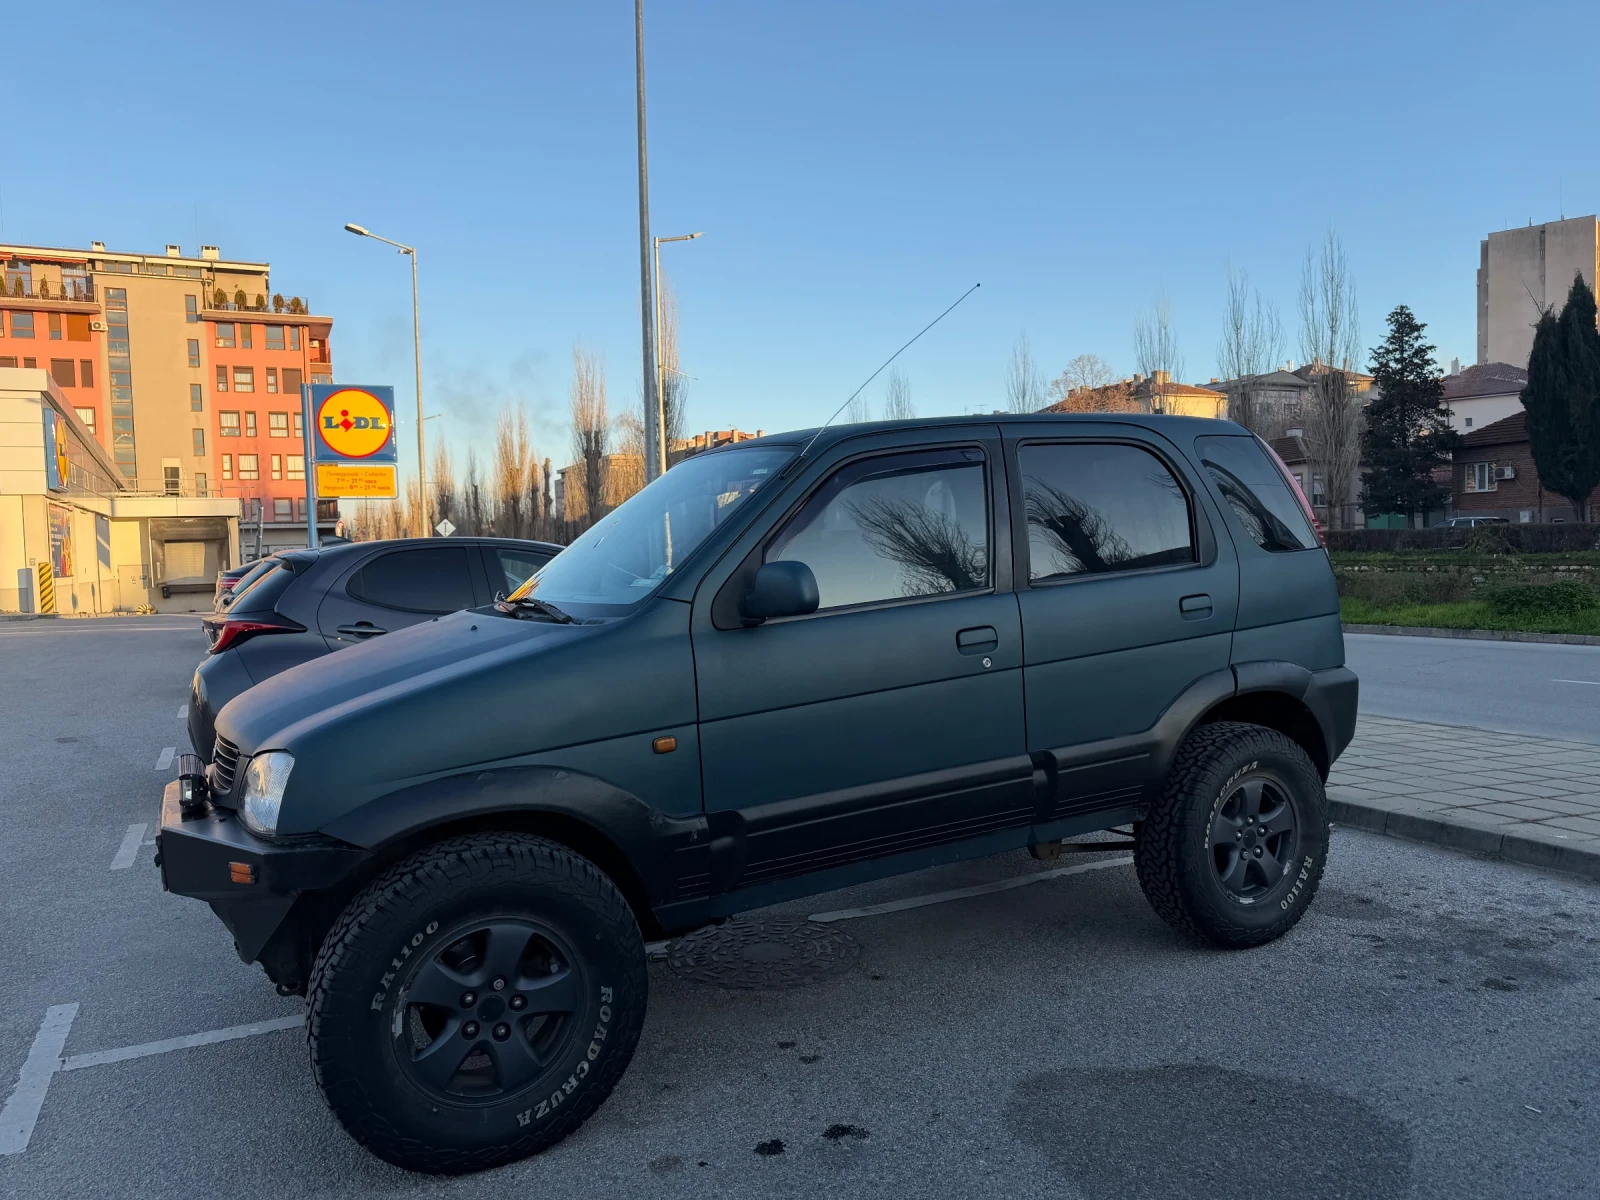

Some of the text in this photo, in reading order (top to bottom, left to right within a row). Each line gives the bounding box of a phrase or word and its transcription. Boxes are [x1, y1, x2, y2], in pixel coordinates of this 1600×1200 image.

[1280, 855, 1313, 910] RA1100
[370, 921, 439, 1012] RA1100
[516, 986, 613, 1127] ROADCRUZA
